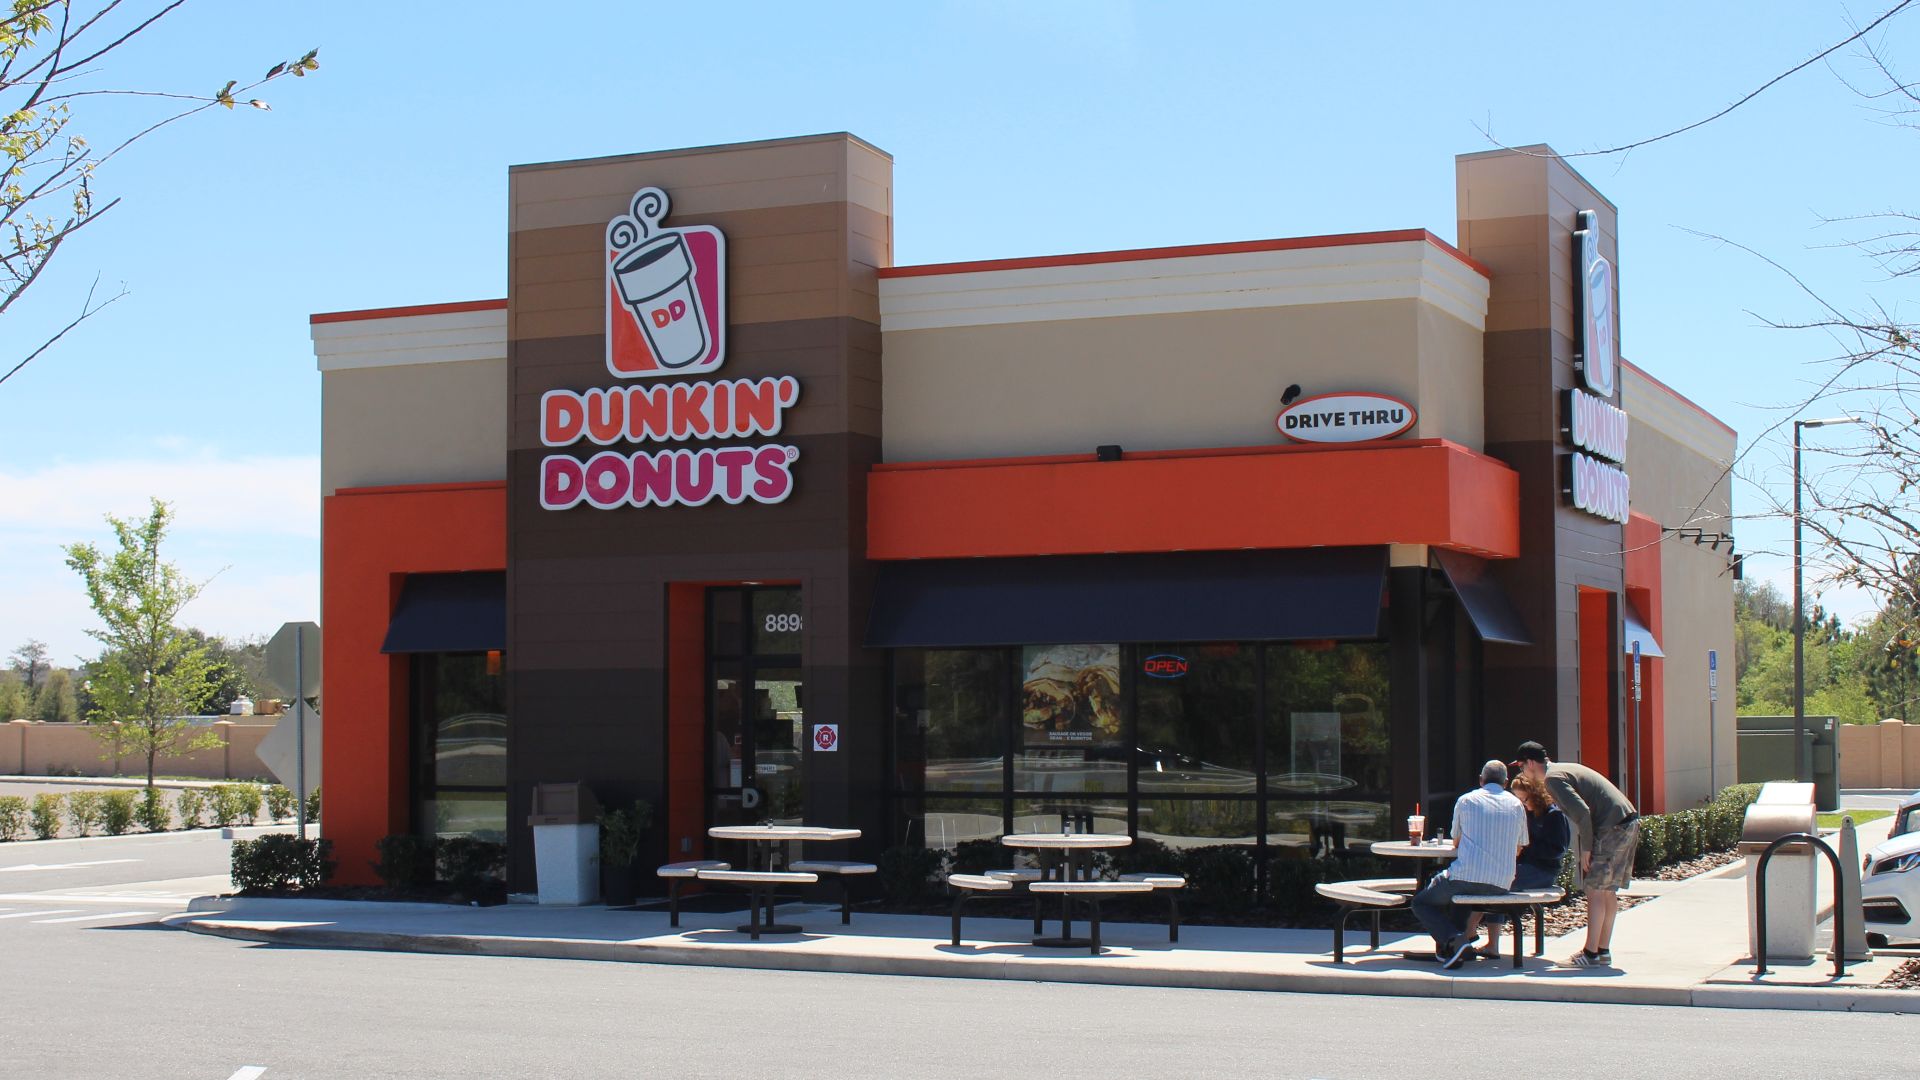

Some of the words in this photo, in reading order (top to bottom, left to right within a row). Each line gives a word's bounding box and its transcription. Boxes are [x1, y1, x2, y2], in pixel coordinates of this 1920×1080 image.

[651, 299, 686, 329] DD
[544, 378, 794, 443] DUNKIN'
[1285, 412, 1346, 430] DRIVE
[1348, 409, 1405, 426] THRU
[1573, 453, 1630, 524] DONUTS
[764, 613, 803, 633] 889
[1143, 658, 1188, 673] OPEN
[822, 734, 829, 742] R
